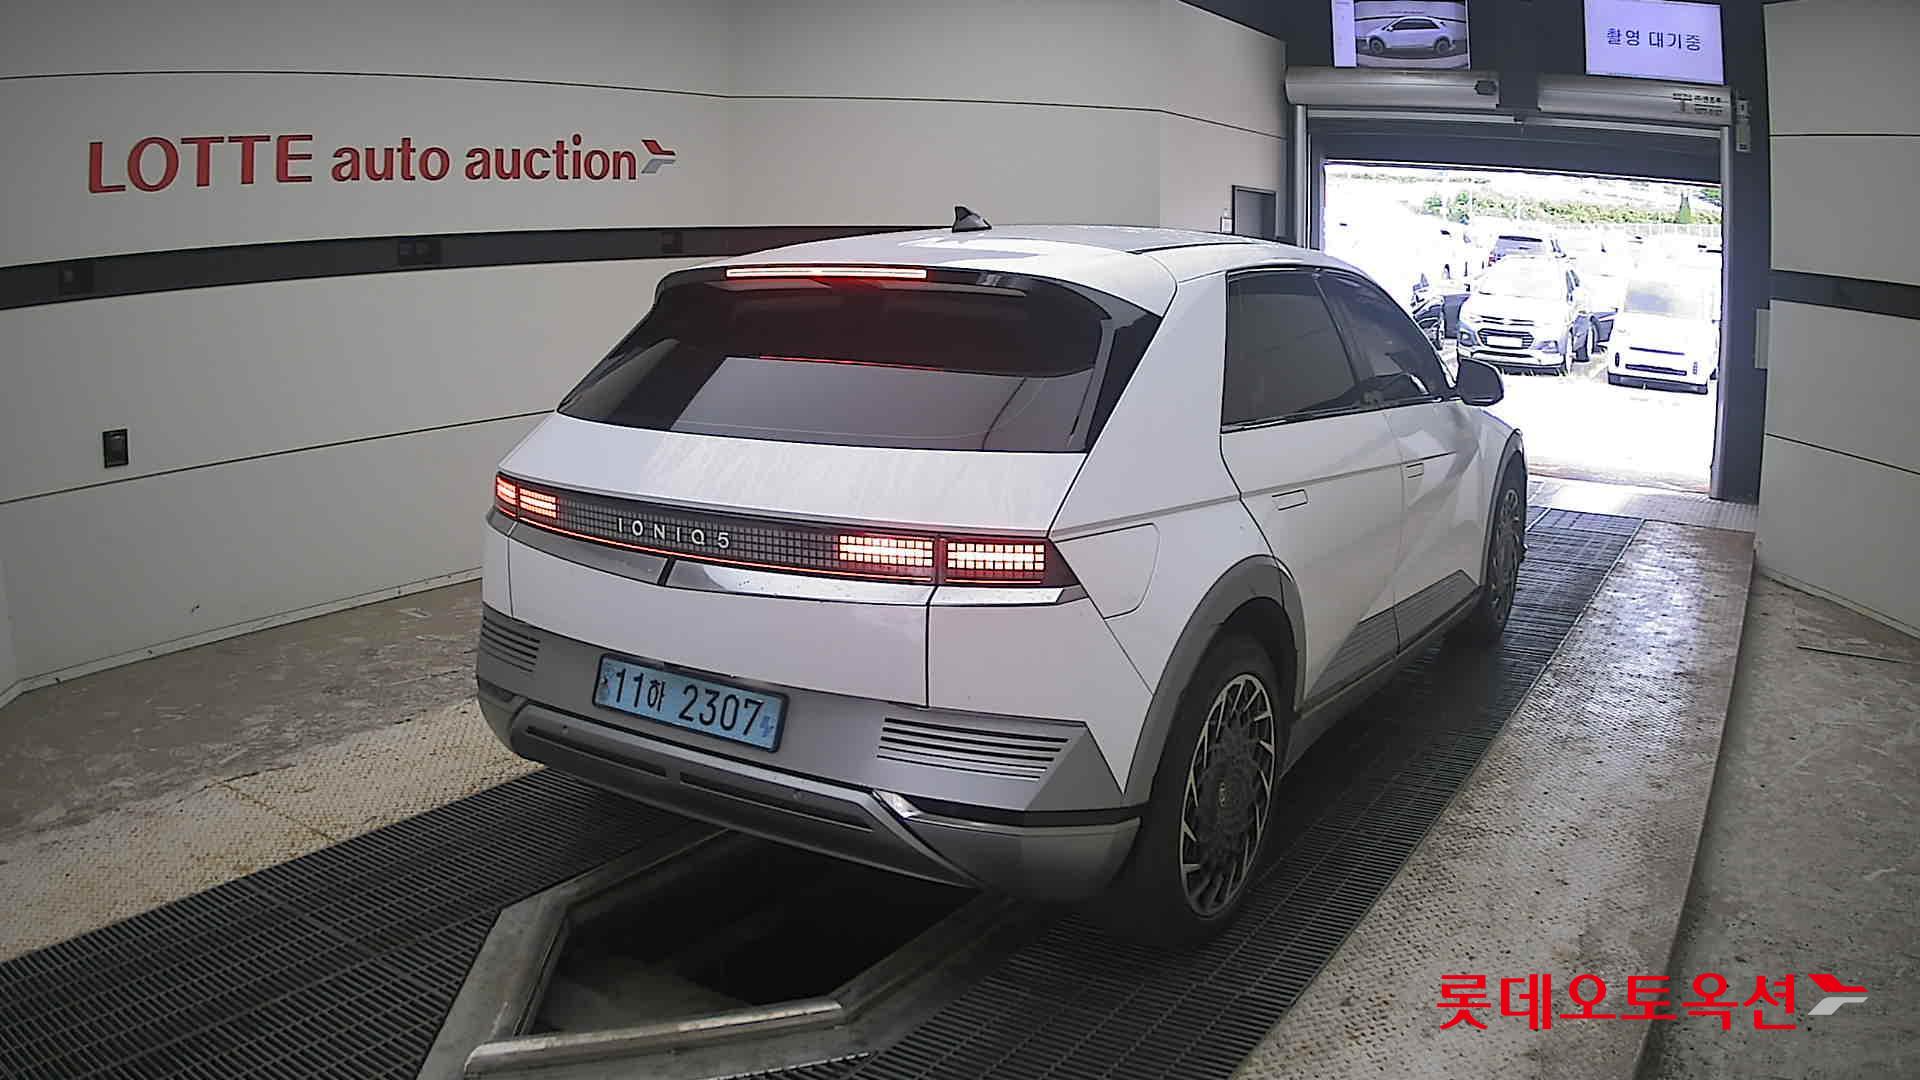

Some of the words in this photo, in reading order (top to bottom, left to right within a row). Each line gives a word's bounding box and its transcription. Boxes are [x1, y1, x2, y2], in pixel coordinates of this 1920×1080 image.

[1648, 31, 1701, 51] 대기중
[87, 133, 314, 194] LOTTE
[331, 136, 451, 182] auto
[463, 132, 639, 182] auction
[615, 667, 667, 713] 11하
[678, 683, 765, 736] 2307
